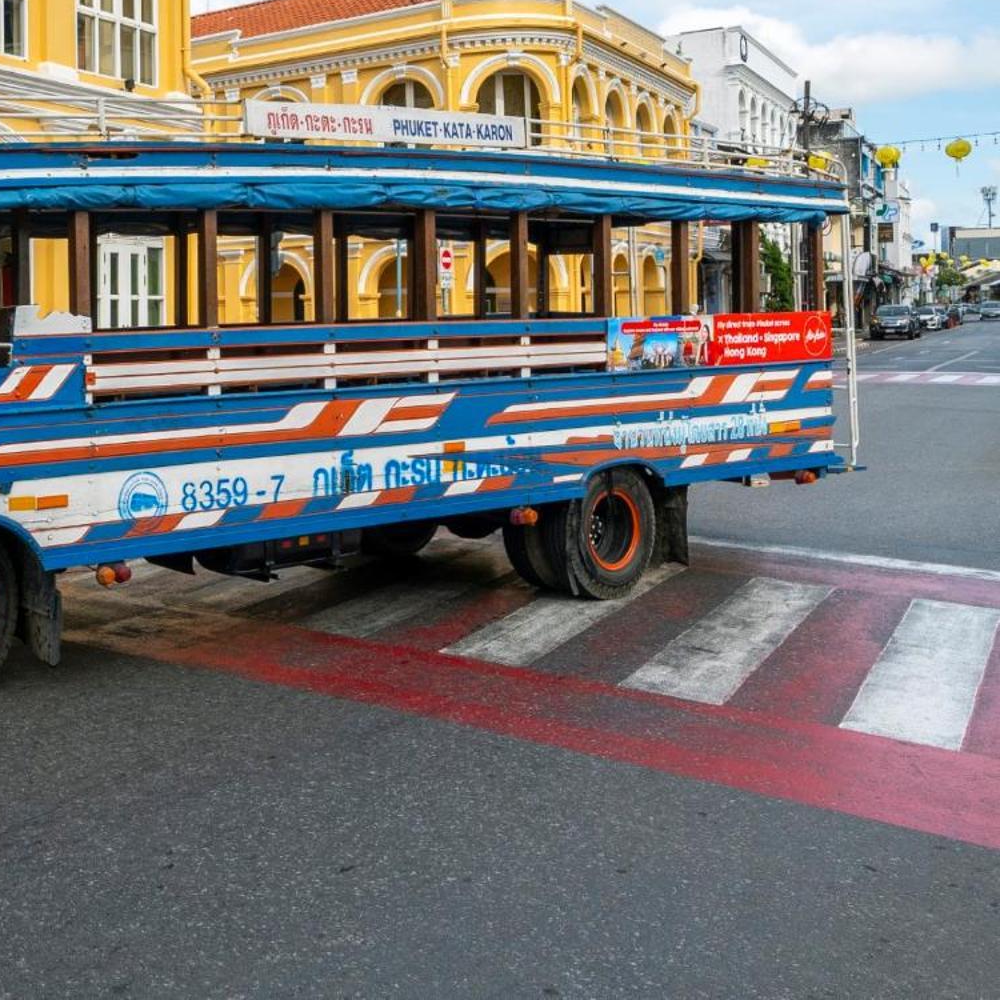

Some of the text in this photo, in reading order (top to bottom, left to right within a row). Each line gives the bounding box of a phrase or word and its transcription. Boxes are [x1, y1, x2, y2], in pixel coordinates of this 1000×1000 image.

[724, 331, 800, 345] Thailand Singapore
[724, 346, 767, 359] Hong Kong
[730, 415, 745, 440] 28
